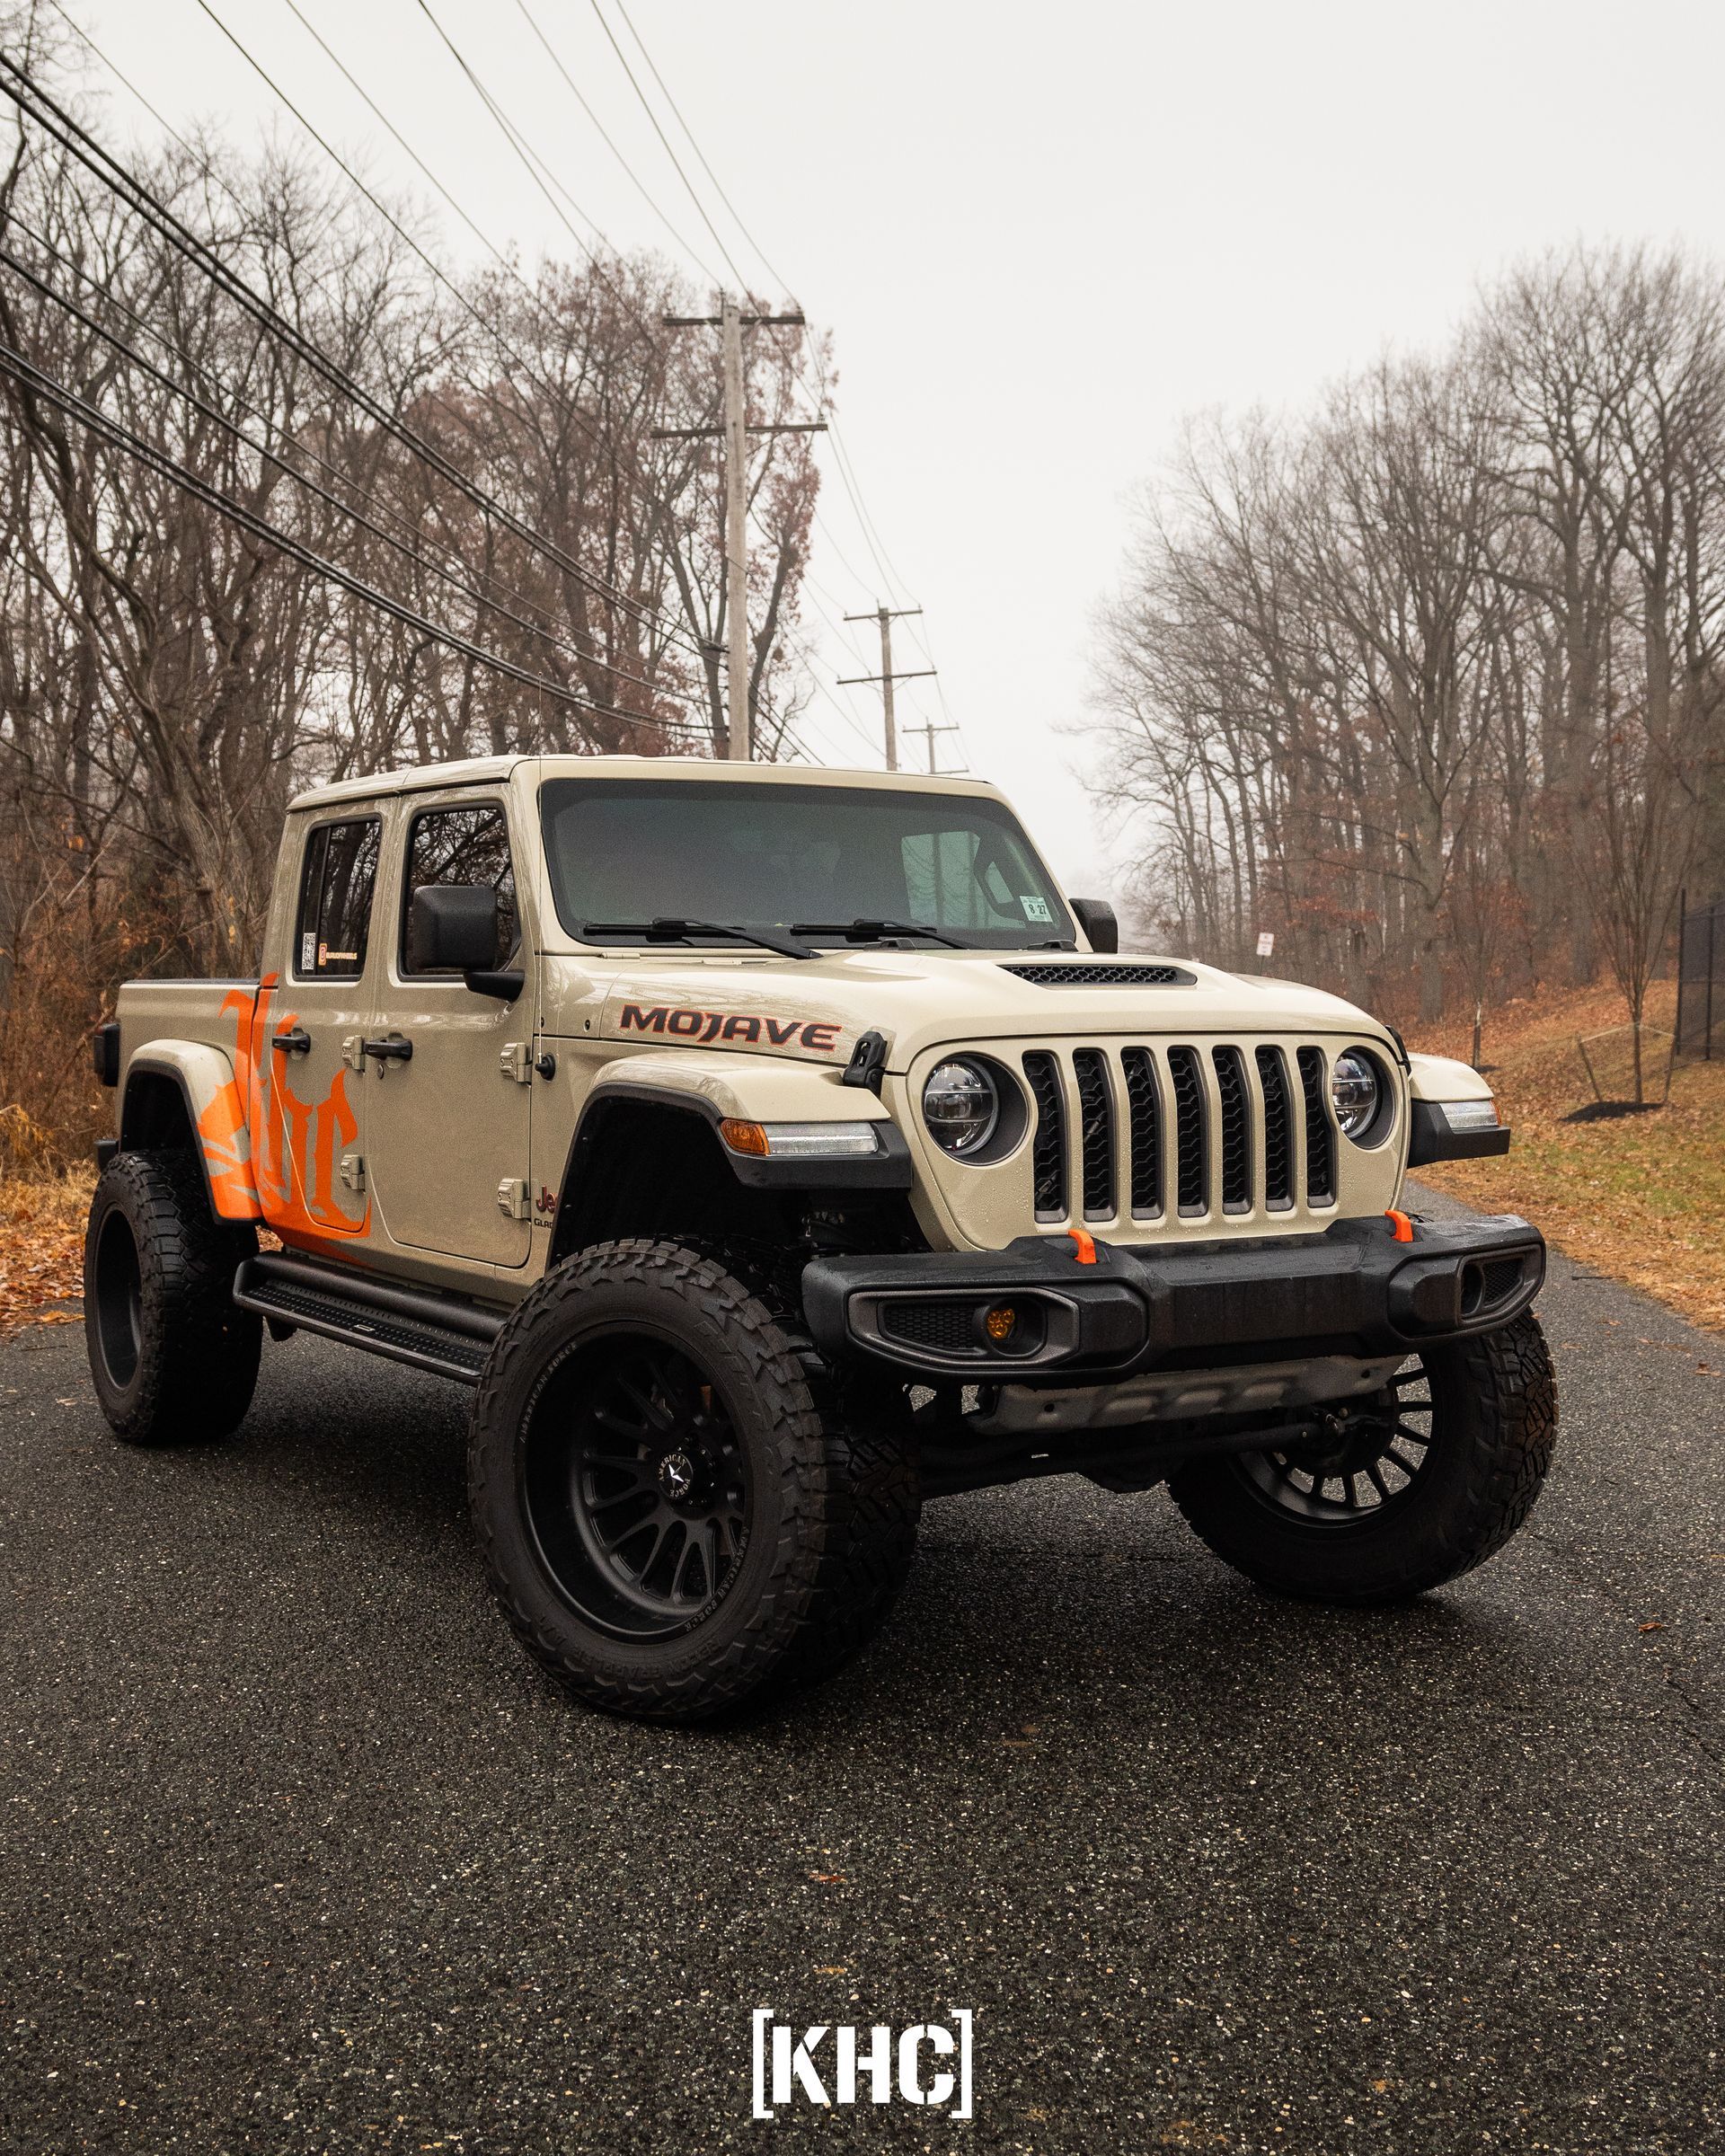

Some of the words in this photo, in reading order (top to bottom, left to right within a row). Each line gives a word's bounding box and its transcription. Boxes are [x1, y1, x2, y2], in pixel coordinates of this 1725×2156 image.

[1028, 904, 1036, 915] 8
[619, 1004, 843, 1051] MOJAVE
[519, 1374, 548, 1444] AMERICAN
[547, 1340, 578, 1374] FORCE
[659, 1454, 687, 1482] AMERICAN
[669, 1478, 691, 1498] FORCE
[717, 1526, 750, 1599] AMERICAN
[684, 1599, 719, 1632] FORCE
